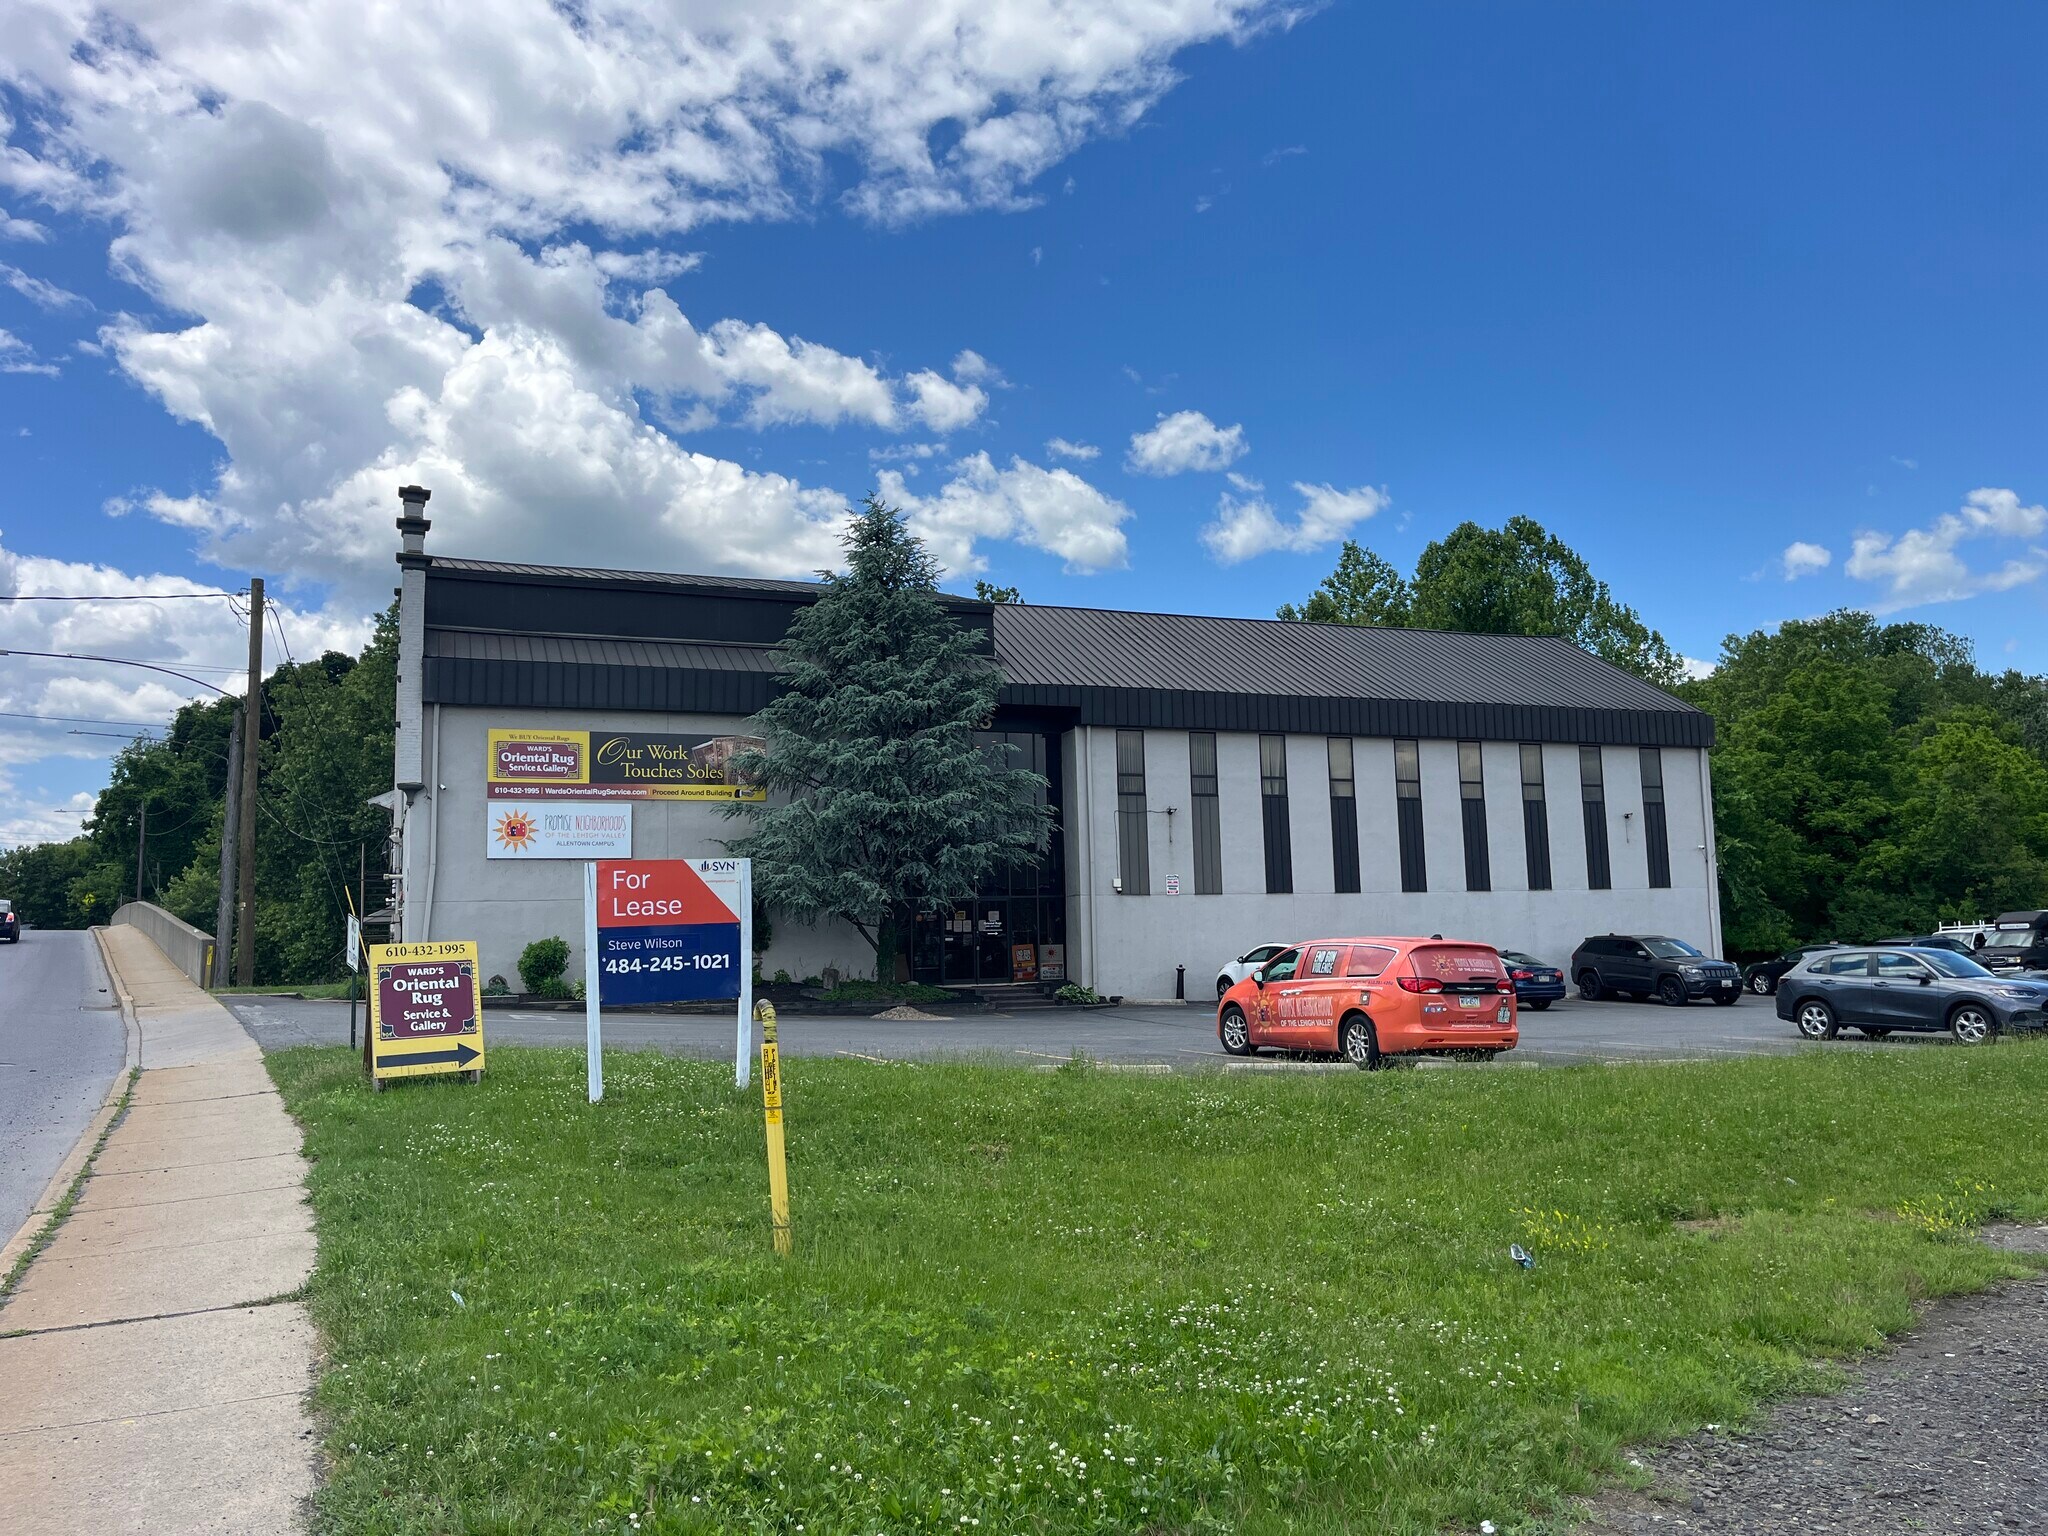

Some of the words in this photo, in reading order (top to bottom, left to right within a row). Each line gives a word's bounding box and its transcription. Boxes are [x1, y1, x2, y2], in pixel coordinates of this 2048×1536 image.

[597, 736, 643, 766] Our
[647, 745, 688, 760] Work
[501, 752, 549, 763] Oriental
[552, 753, 574, 766] Rug
[509, 763, 535, 772] Service
[543, 764, 569, 774] Gallery
[620, 762, 683, 778] Touches
[687, 763, 724, 779] Soles
[494, 786, 540, 794] 610-432-1995
[545, 787, 647, 796] WardsOrientalRugService.com
[706, 789, 732, 798] Building
[544, 814, 573, 831] PROMISE
[575, 815, 627, 831] NEIGHBORHOODS
[712, 861, 736, 871] SVN
[613, 870, 651, 890] For
[613, 897, 682, 917] Lease
[386, 944, 465, 957] 610-432-1995
[608, 940, 641, 951] Steve
[644, 938, 683, 949] Wilson
[606, 954, 730, 974] 484-245-1021
[407, 967, 444, 976] WARD'S
[393, 976, 460, 991] Oriental
[412, 992, 443, 1006] Rug
[403, 1009, 441, 1020] Service
[442, 1008, 452, 1018] &
[410, 1021, 447, 1031] Gallery
[1280, 1019, 1287, 1027] OF
[1287, 1019, 1297, 1027] THE
[1316, 1018, 1334, 1026] VALLEY
